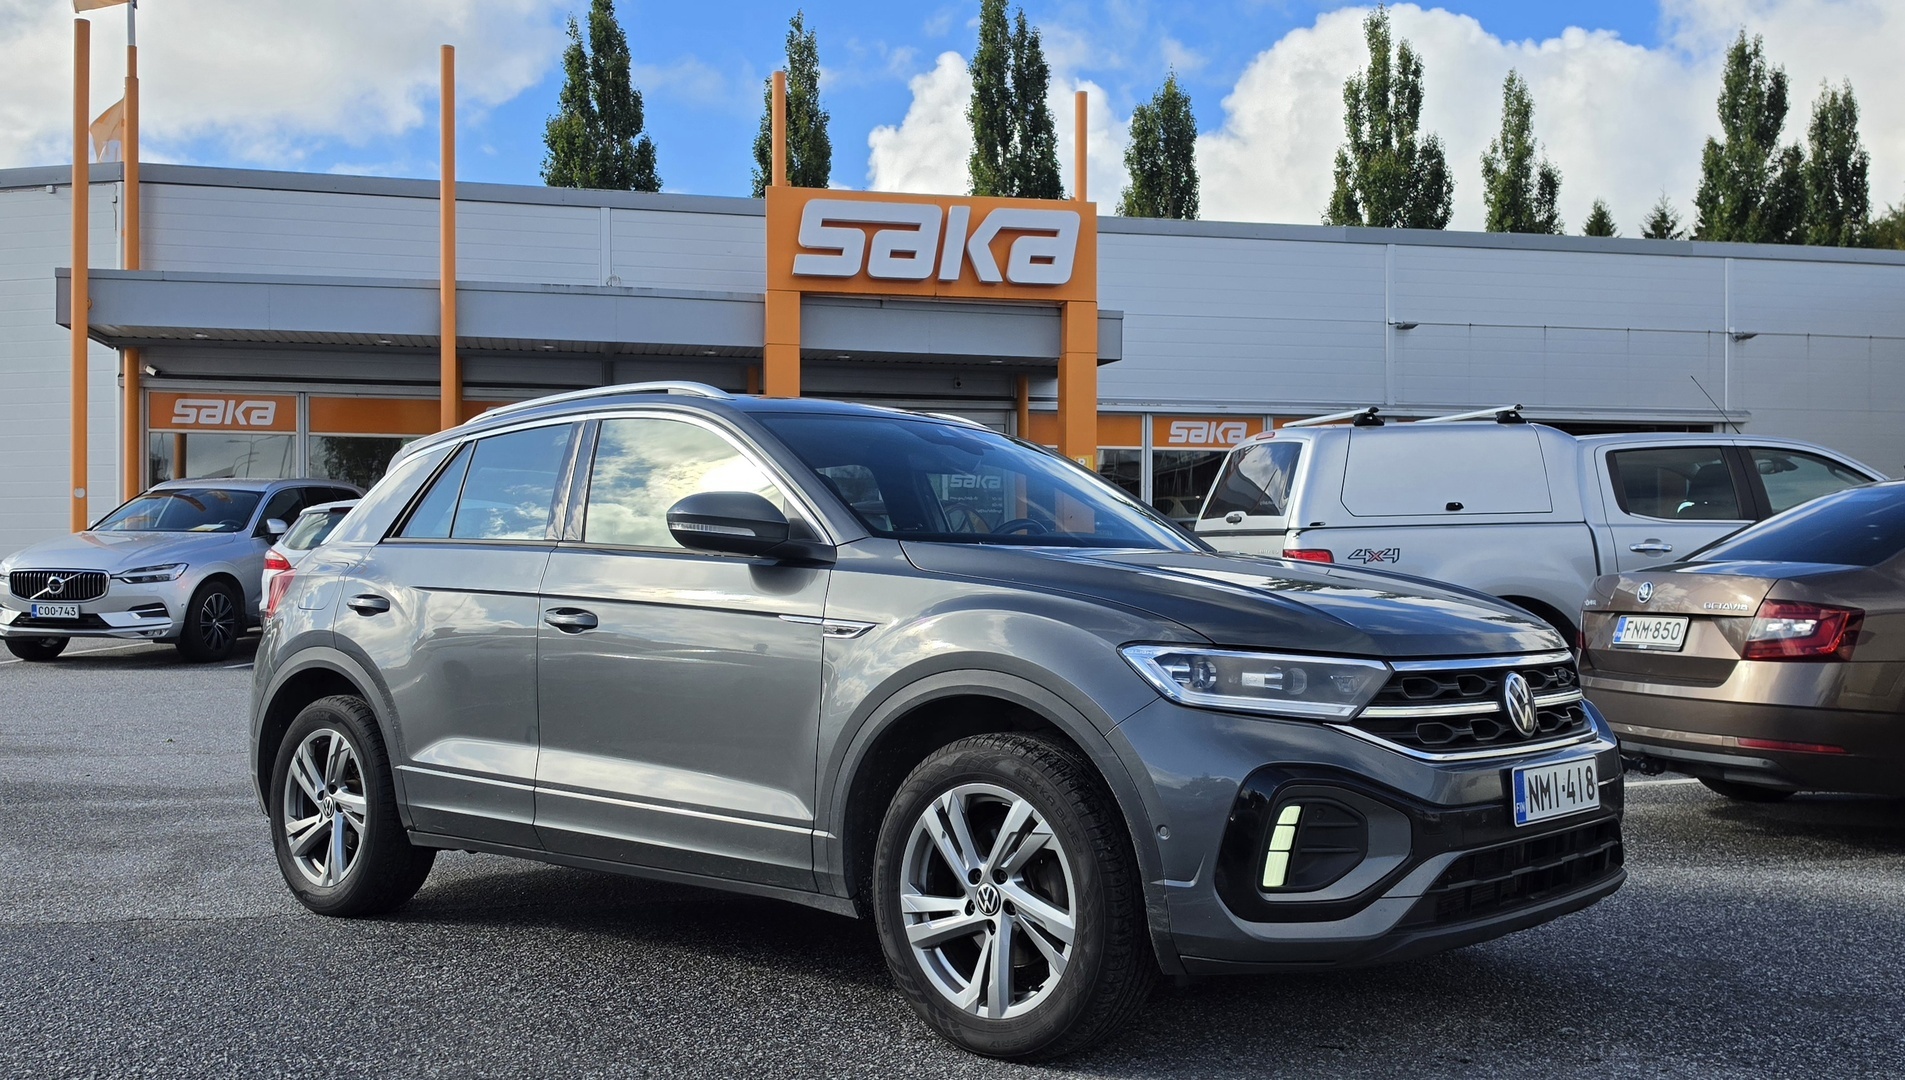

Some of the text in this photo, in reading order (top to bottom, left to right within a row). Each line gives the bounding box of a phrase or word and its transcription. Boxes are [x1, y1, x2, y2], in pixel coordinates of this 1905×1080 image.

[1703, 602, 1748, 611] OCTAVIA
[1626, 620, 1682, 641] FNM-850
[1516, 765, 1596, 814] FIN NMI-418
